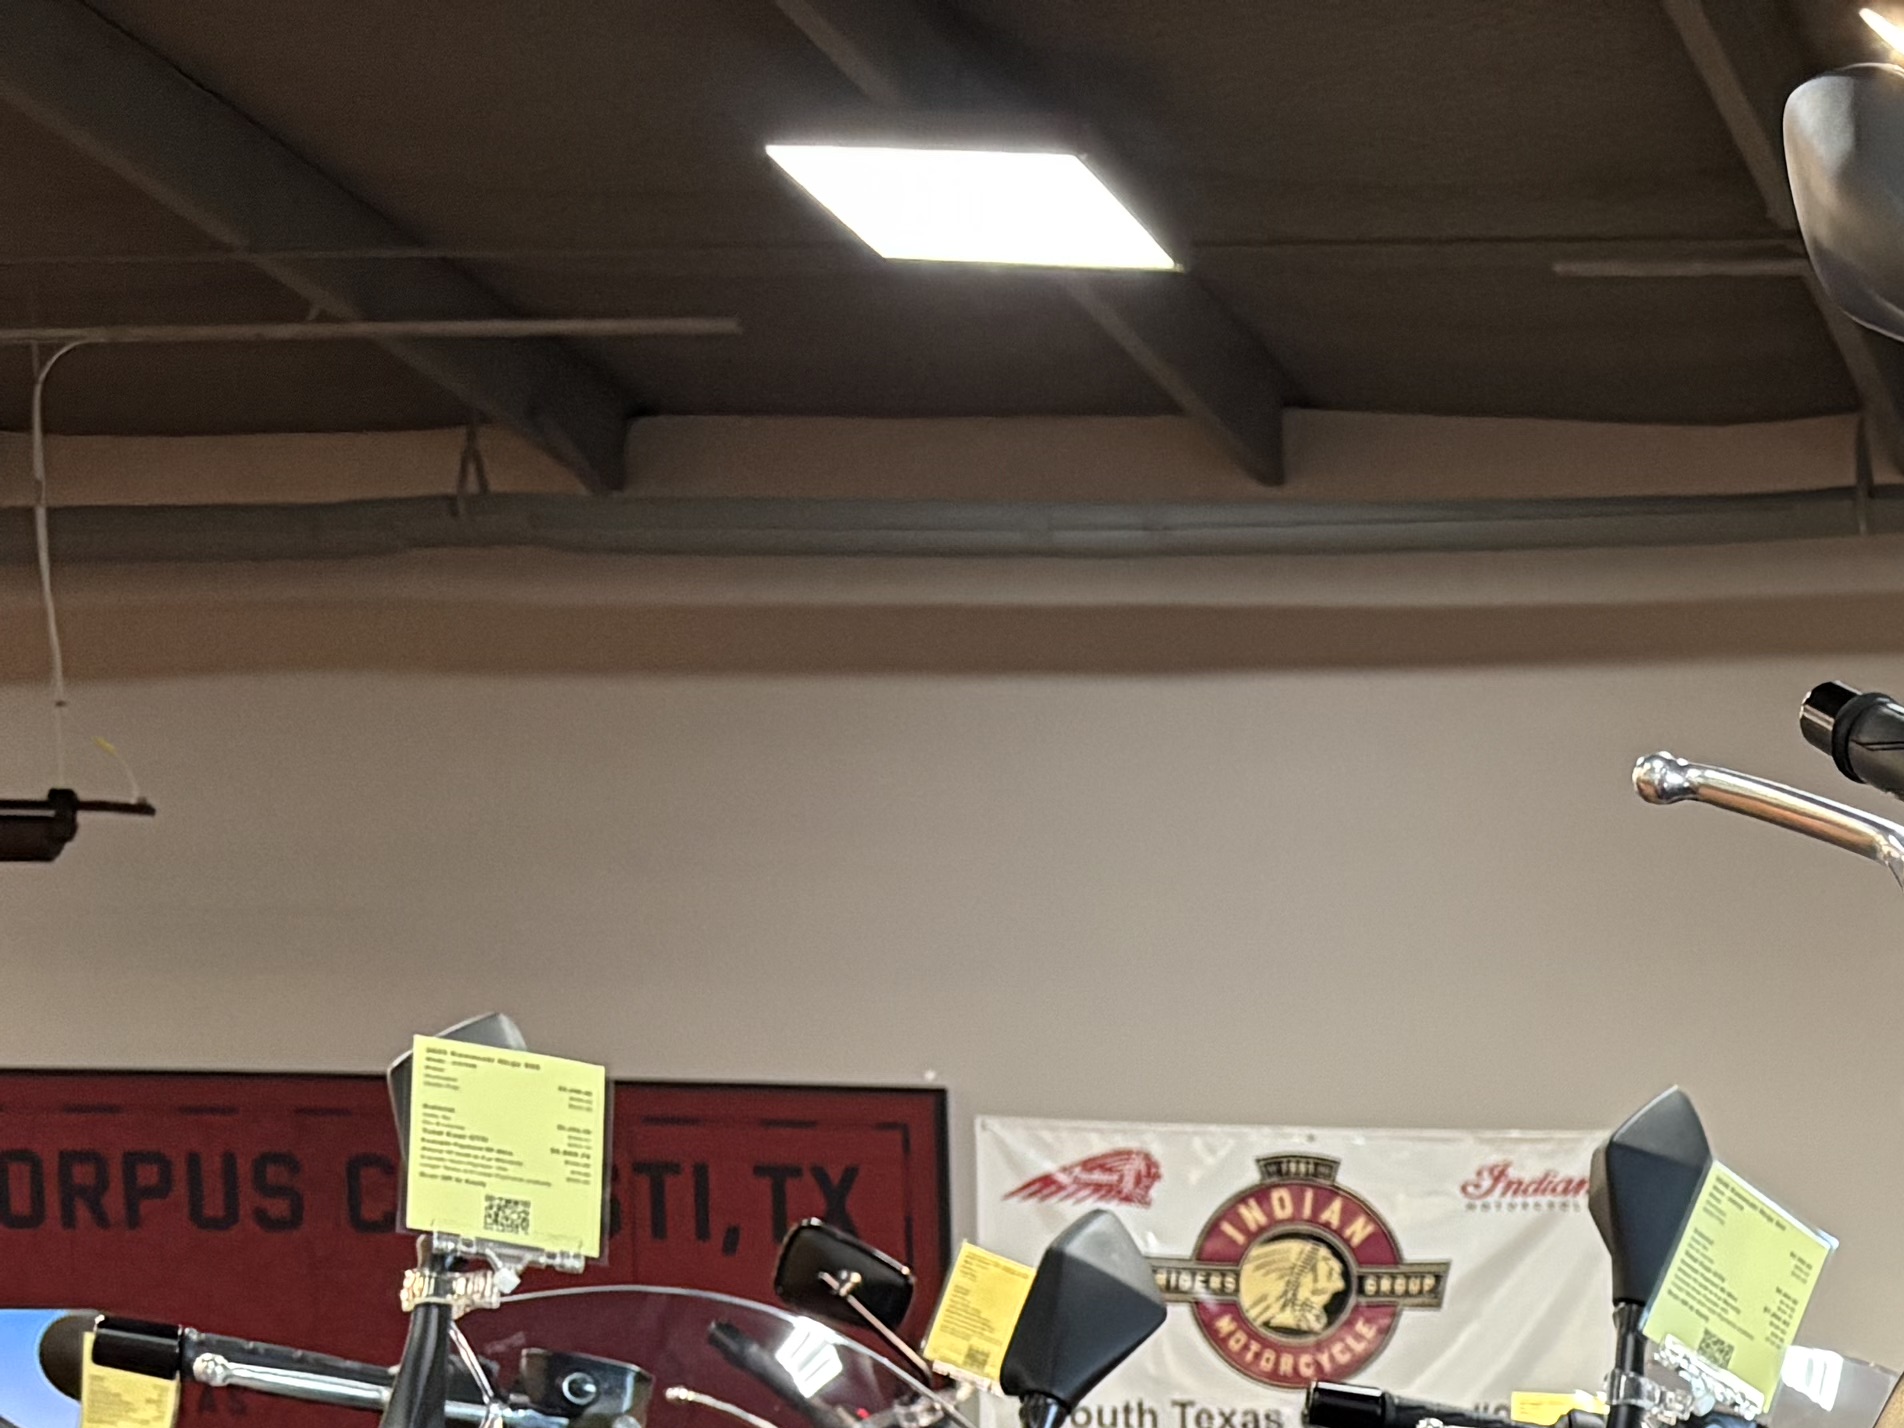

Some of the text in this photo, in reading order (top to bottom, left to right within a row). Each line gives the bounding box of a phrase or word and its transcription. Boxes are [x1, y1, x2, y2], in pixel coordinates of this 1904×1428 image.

[1219, 1186, 1377, 1248] INDIAN
[1363, 1273, 1437, 1297] GROUP
[1214, 1313, 1379, 1379] MOTORCYCLE
